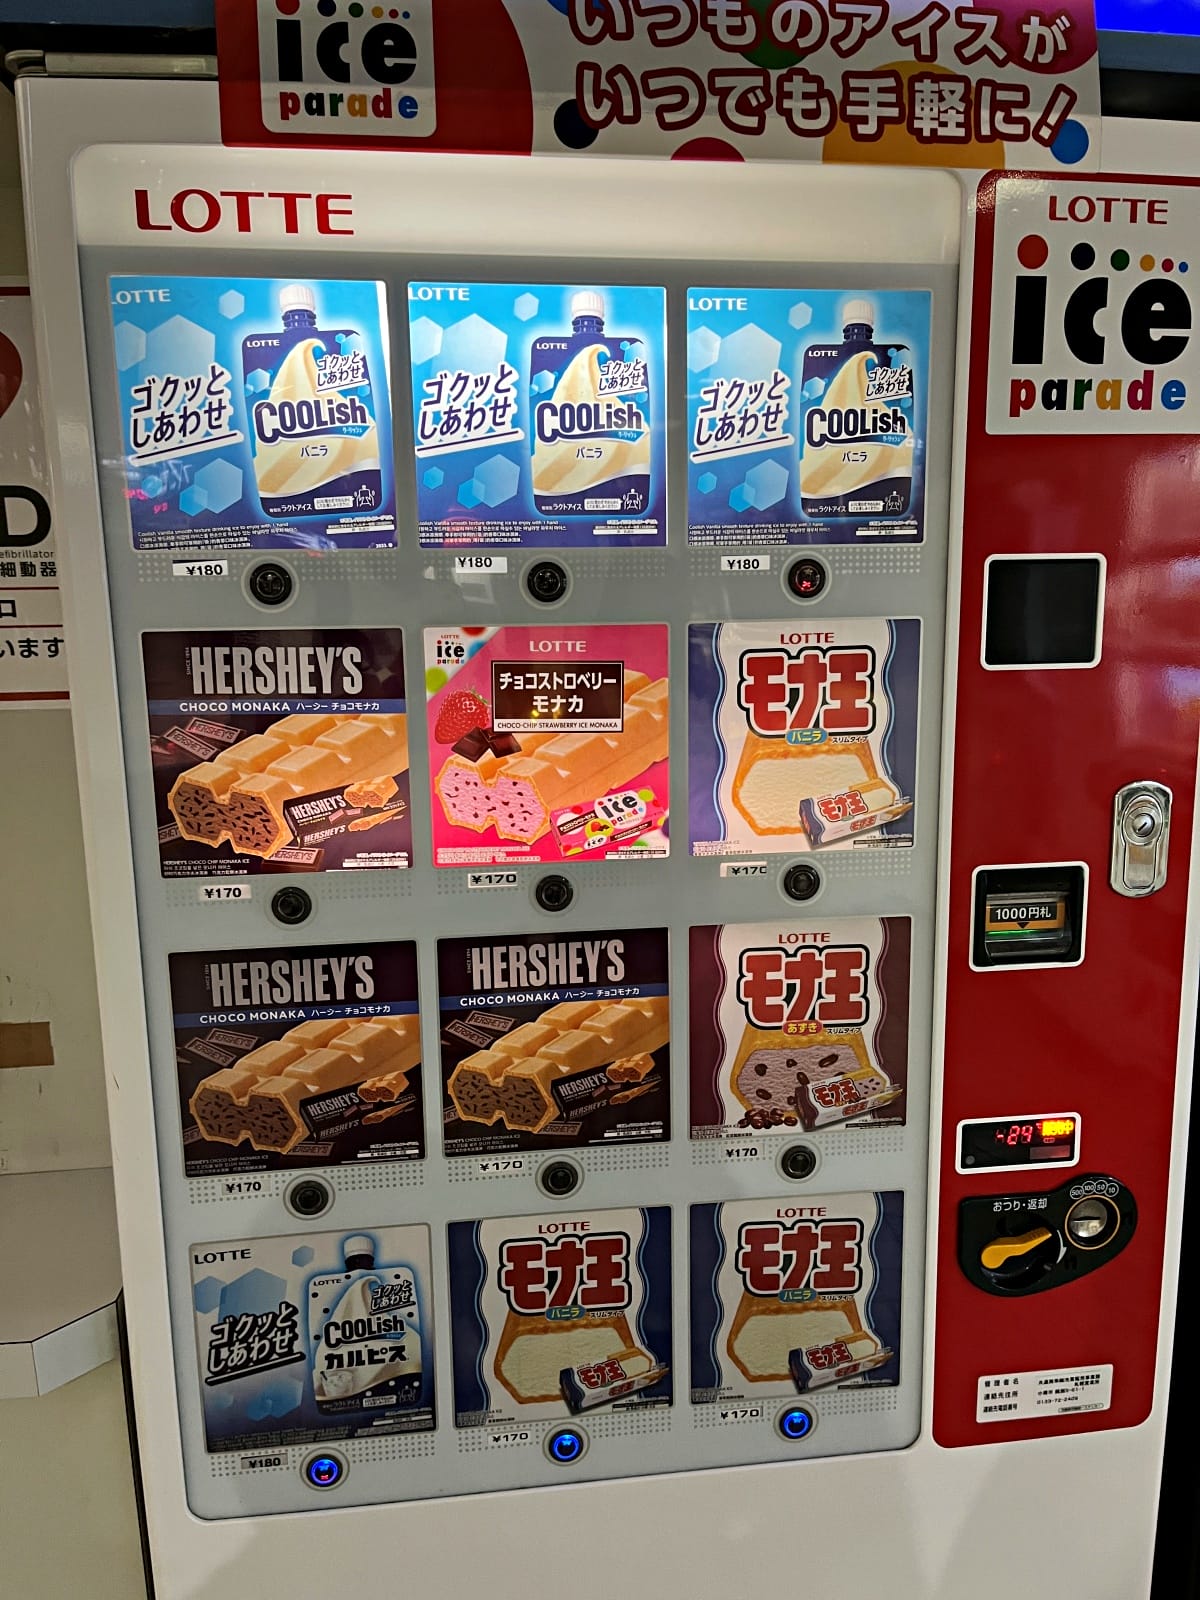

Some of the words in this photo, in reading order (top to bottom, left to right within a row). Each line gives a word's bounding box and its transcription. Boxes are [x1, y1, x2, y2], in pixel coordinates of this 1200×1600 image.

[276, 0, 417, 84] ice
[569, 0, 1071, 67] いつものアイスが
[280, 88, 418, 120] parade
[576, 61, 1076, 147] いつでも手軽に!
[134, 188, 354, 235] LOTTE
[1048, 195, 1168, 225] LOTTE
[112, 289, 171, 304] OTTE
[409, 287, 470, 301] LOTTE
[1012, 235, 1192, 365] ice
[689, 298, 747, 311] LOTTE
[246, 339, 280, 348] LOTTE
[536, 342, 568, 350] LOTTE
[317, 350, 361, 371] ゴクッと
[600, 358, 641, 377] ゴクッと
[316, 366, 361, 387] しあわせ
[599, 373, 641, 391] しあわせ
[869, 364, 908, 382] ゴクッと
[132, 365, 225, 415] ゴクッと
[424, 364, 513, 406] ゴクッと
[700, 372, 786, 413] ゴクッと
[867, 379, 906, 396] しあわせ
[1009, 369, 1186, 418] parade
[132, 397, 226, 448] しあわせ
[255, 398, 367, 443] COOLish
[419, 397, 511, 440] しあわせ
[537, 402, 643, 443] COOLish
[696, 404, 783, 446] しあわせ
[807, 408, 906, 448] COOLish
[300, 445, 328, 458] バニラ
[576, 447, 602, 459] バニラ
[842, 452, 868, 463] バニラ
[281, 503, 312, 513] ラクトアイス
[552, 503, 582, 511] ラクトアイス
[185, 564, 223, 576] ¥180
[529, 640, 586, 653] LOTTE
[780, 632, 835, 645] LOTTE
[437, 640, 464, 658] ice
[191, 646, 363, 695] HERSHEY'S
[499, 672, 617, 690] チョコストロベリー
[742, 649, 872, 734] モナ王
[179, 702, 228, 712] CHOCO
[232, 702, 291, 711] MONAKA
[331, 702, 379, 711] チョコモナカ
[532, 695, 584, 713] モナカ
[791, 730, 823, 743] バニラ
[832, 736, 869, 744] スリムタイプ
[291, 795, 346, 819] HERSHEY'S
[598, 795, 638, 819] ice
[818, 791, 868, 821] モナ王
[304, 825, 346, 842] HERSHEY'S
[472, 874, 517, 884] ¥170
[204, 887, 242, 898] ¥170
[995, 906, 1051, 921] 1000円札
[778, 932, 831, 944] LOTTE
[471, 939, 625, 990] HERSHEY'S
[210, 955, 374, 1007] HERSHEY'S
[740, 948, 866, 1026] モナ王
[460, 996, 504, 1007] CHOCO
[507, 992, 560, 1003] MONAKA
[565, 990, 593, 999] ハーシー
[596, 987, 640, 997] チョコモナカ
[199, 1013, 246, 1024] CHOCO
[250, 1009, 306, 1021] MONAKA
[311, 1007, 342, 1017] ハーシー
[345, 1005, 391, 1016] チョコモナカ
[787, 1021, 817, 1033] あずき
[826, 1027, 862, 1035] スリムタイプ
[558, 1073, 607, 1096] HERSHEY'S
[813, 1078, 860, 1108] モナ王
[307, 1092, 359, 1116] HERSHEY'S
[726, 1147, 757, 1158] ¥170
[479, 1160, 523, 1171] ¥170
[226, 1181, 261, 1193] ¥170
[776, 1207, 827, 1218] LOTTE
[993, 1198, 1048, 1212] おつり・返却
[538, 1221, 591, 1234] LOTTE
[194, 1249, 252, 1265] LOTTE
[739, 1222, 860, 1294] モナ王
[313, 1278, 341, 1286] LOTTE
[502, 1235, 628, 1313] モナ王
[374, 1280, 412, 1299] ゴクッと
[782, 1289, 813, 1301] バニラ
[371, 1292, 411, 1310] しあわせ
[551, 1307, 580, 1319] バニラ
[590, 1310, 625, 1318] スリムタイプ
[210, 1302, 297, 1348] ゴクッと
[324, 1315, 405, 1348] COOLish
[208, 1330, 295, 1374] しあわせ
[325, 1345, 407, 1370] カルピス
[806, 1341, 853, 1370] モナ王
[577, 1360, 626, 1389] モナ王
[720, 1409, 759, 1420] ¥170
[492, 1432, 528, 1443] ¥170
[249, 1457, 281, 1469] ¥180
